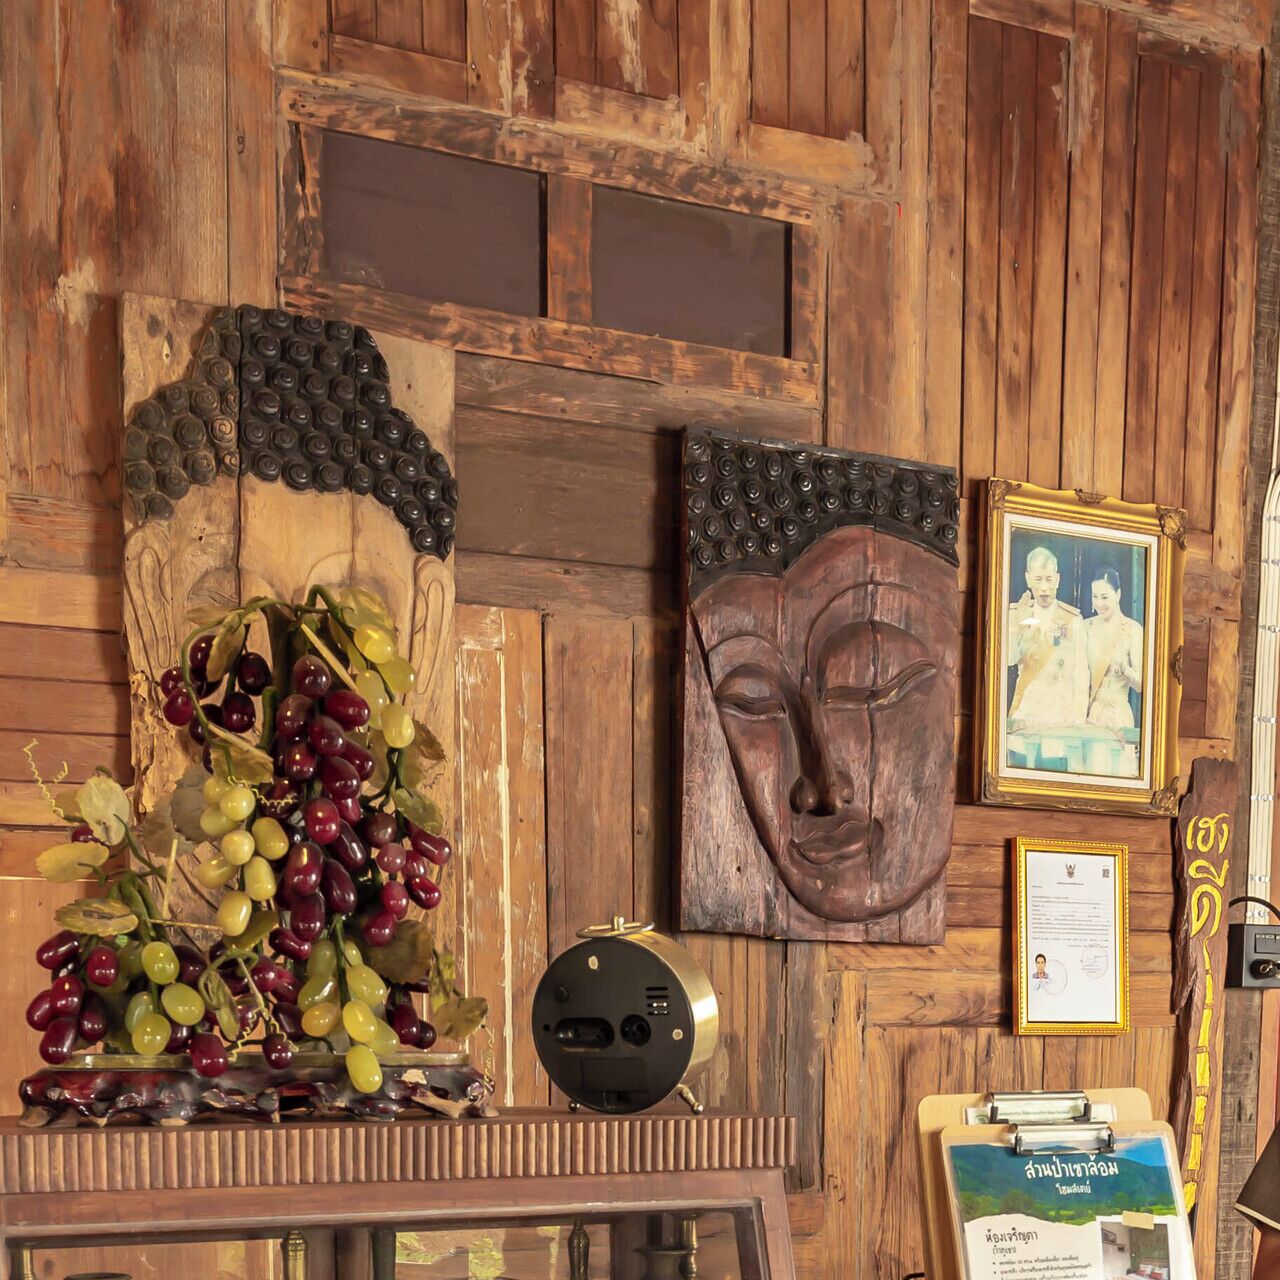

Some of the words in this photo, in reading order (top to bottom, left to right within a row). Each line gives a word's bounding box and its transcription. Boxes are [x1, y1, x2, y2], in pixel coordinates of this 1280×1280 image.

[1185, 812, 1231, 855] เฮง
[1024, 1156, 1120, 1181] สวนป่าเขาล้อม
[1056, 1180, 1092, 1196] โฮมสเตย์
